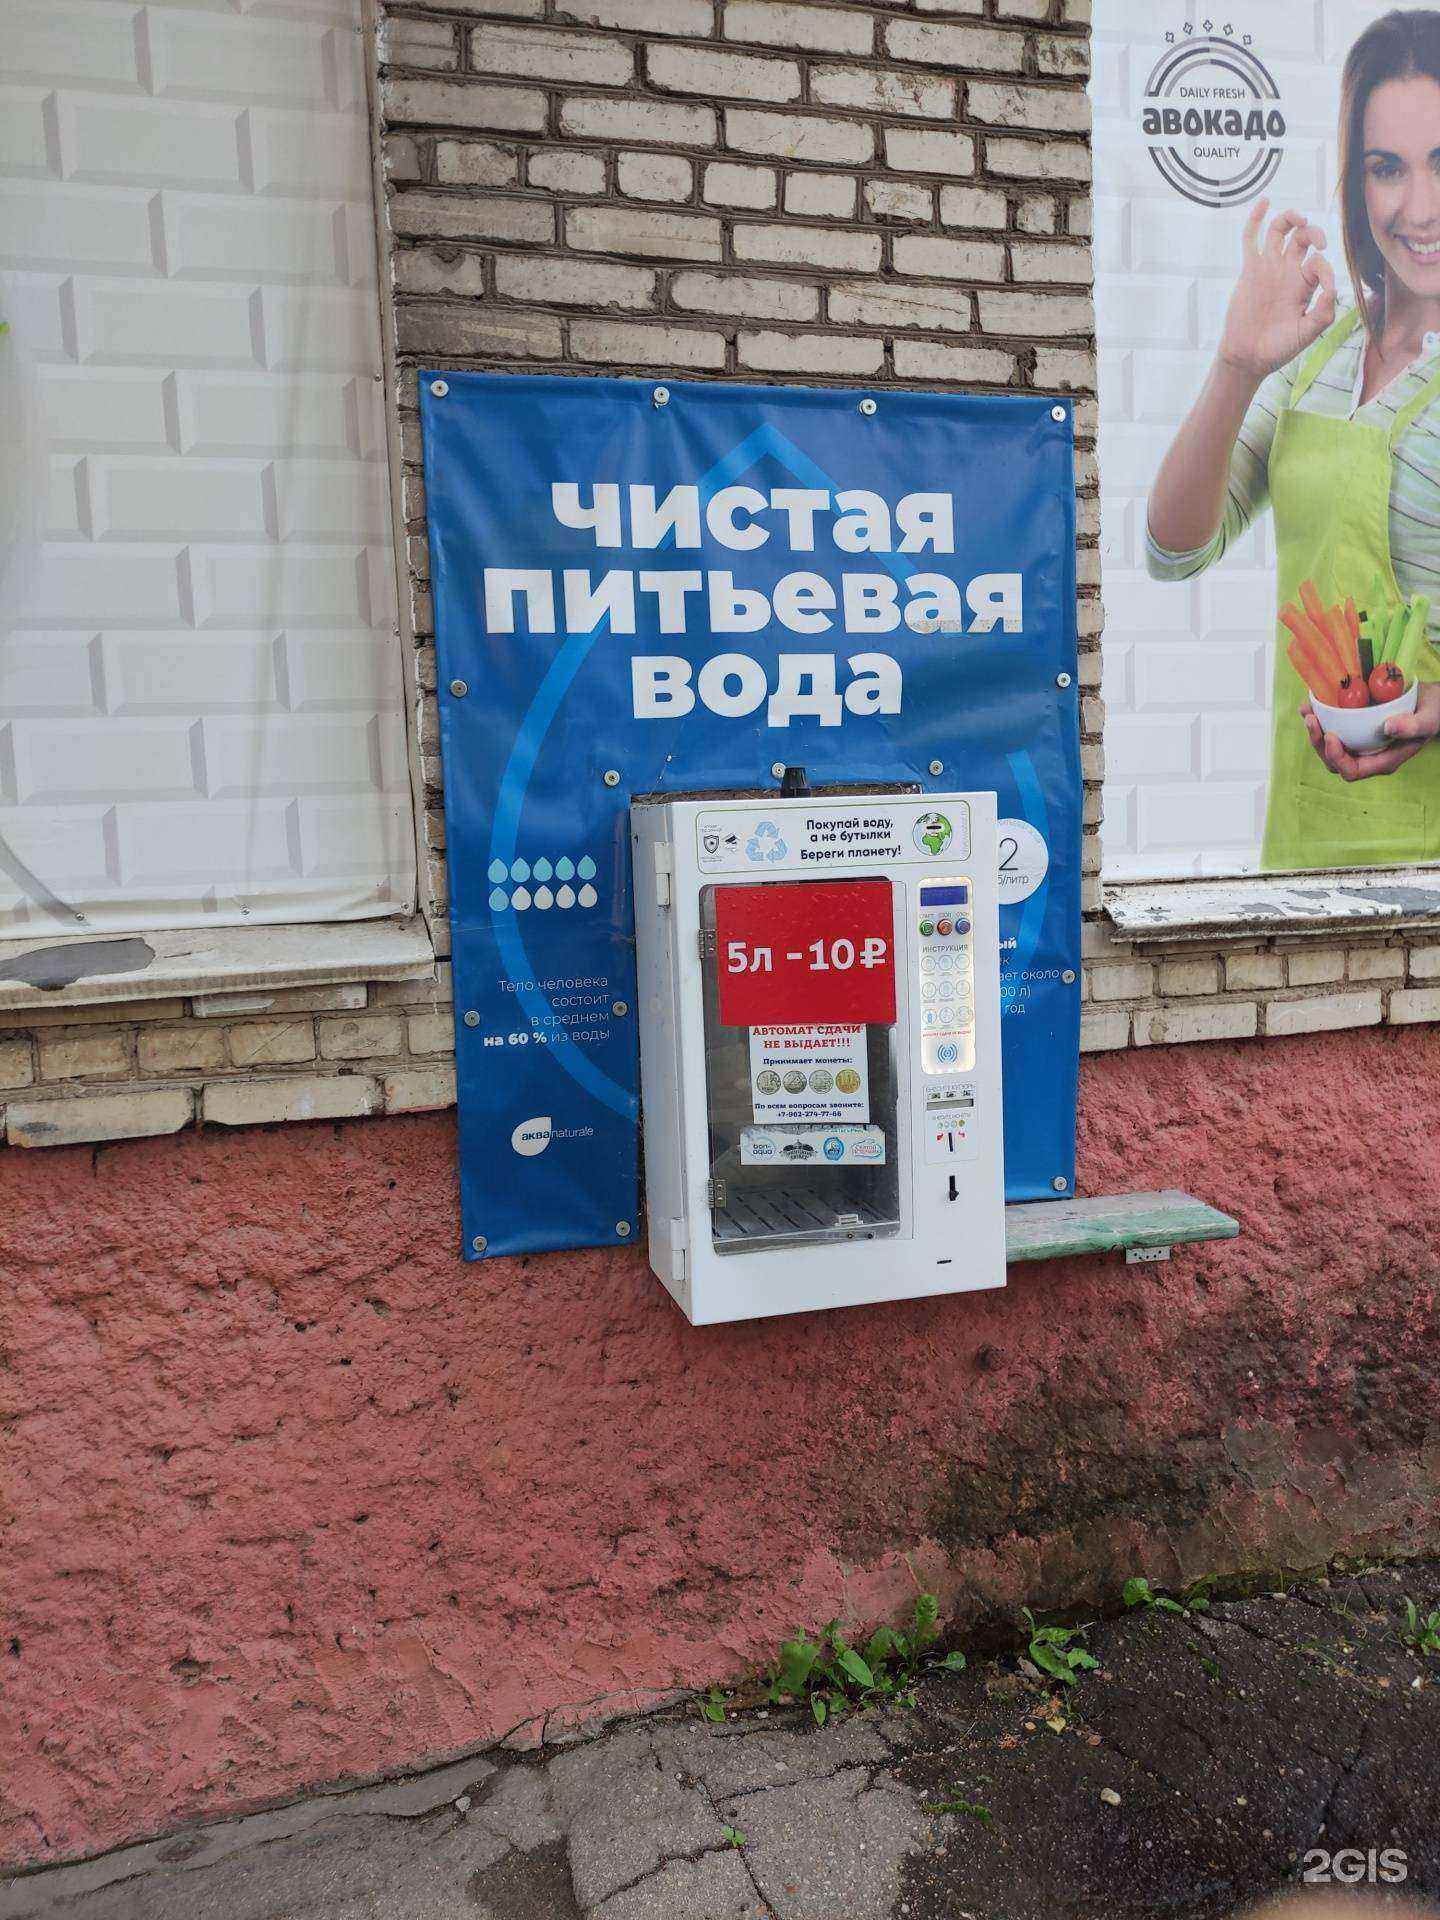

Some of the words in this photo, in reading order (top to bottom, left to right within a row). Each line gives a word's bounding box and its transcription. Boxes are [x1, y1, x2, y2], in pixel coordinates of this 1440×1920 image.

[1180, 87, 1210, 99] DAILY
[1213, 88, 1245, 99] FRESH
[1142, 108, 1286, 141] авокадо
[1193, 147, 1240, 158] QUALITY
[552, 482, 955, 553] чистая
[484, 568, 1023, 634] питьевая
[631, 652, 902, 727] вода
[806, 818, 860, 833] Покупай
[863, 818, 894, 831] воду,
[810, 833, 818, 842] а
[823, 832, 837, 841] не
[840, 830, 891, 842] бутылки
[800, 849, 845, 861] Береги
[848, 845, 902, 859] планету!
[922, 944, 969, 953] ИНСТРУКЦИЯ
[727, 941, 773, 973] 5л
[1021, 968, 1060, 981] около
[499, 980, 534, 992] Тело
[538, 977, 608, 989] человека
[1019, 985, 1031, 998] л)
[552, 994, 609, 1007] состоит
[1005, 1003, 1026, 1015] год
[531, 1016, 540, 1026] в
[543, 1012, 609, 1028] среднем
[753, 1026, 814, 1036] АВТОМАТ
[817, 1024, 861, 1035] СДАЧИ
[484, 1036, 504, 1047] на
[508, 1033, 529, 1045] 60
[532, 1032, 548, 1044] %
[552, 1033, 569, 1042] из
[572, 1030, 610, 1042] воды
[763, 1040, 780, 1049] НЕ
[784, 1038, 850, 1050] ВЫДАЕТ!!!
[763, 1058, 813, 1066] Принимает
[788, 1103, 827, 1111] вопросам
